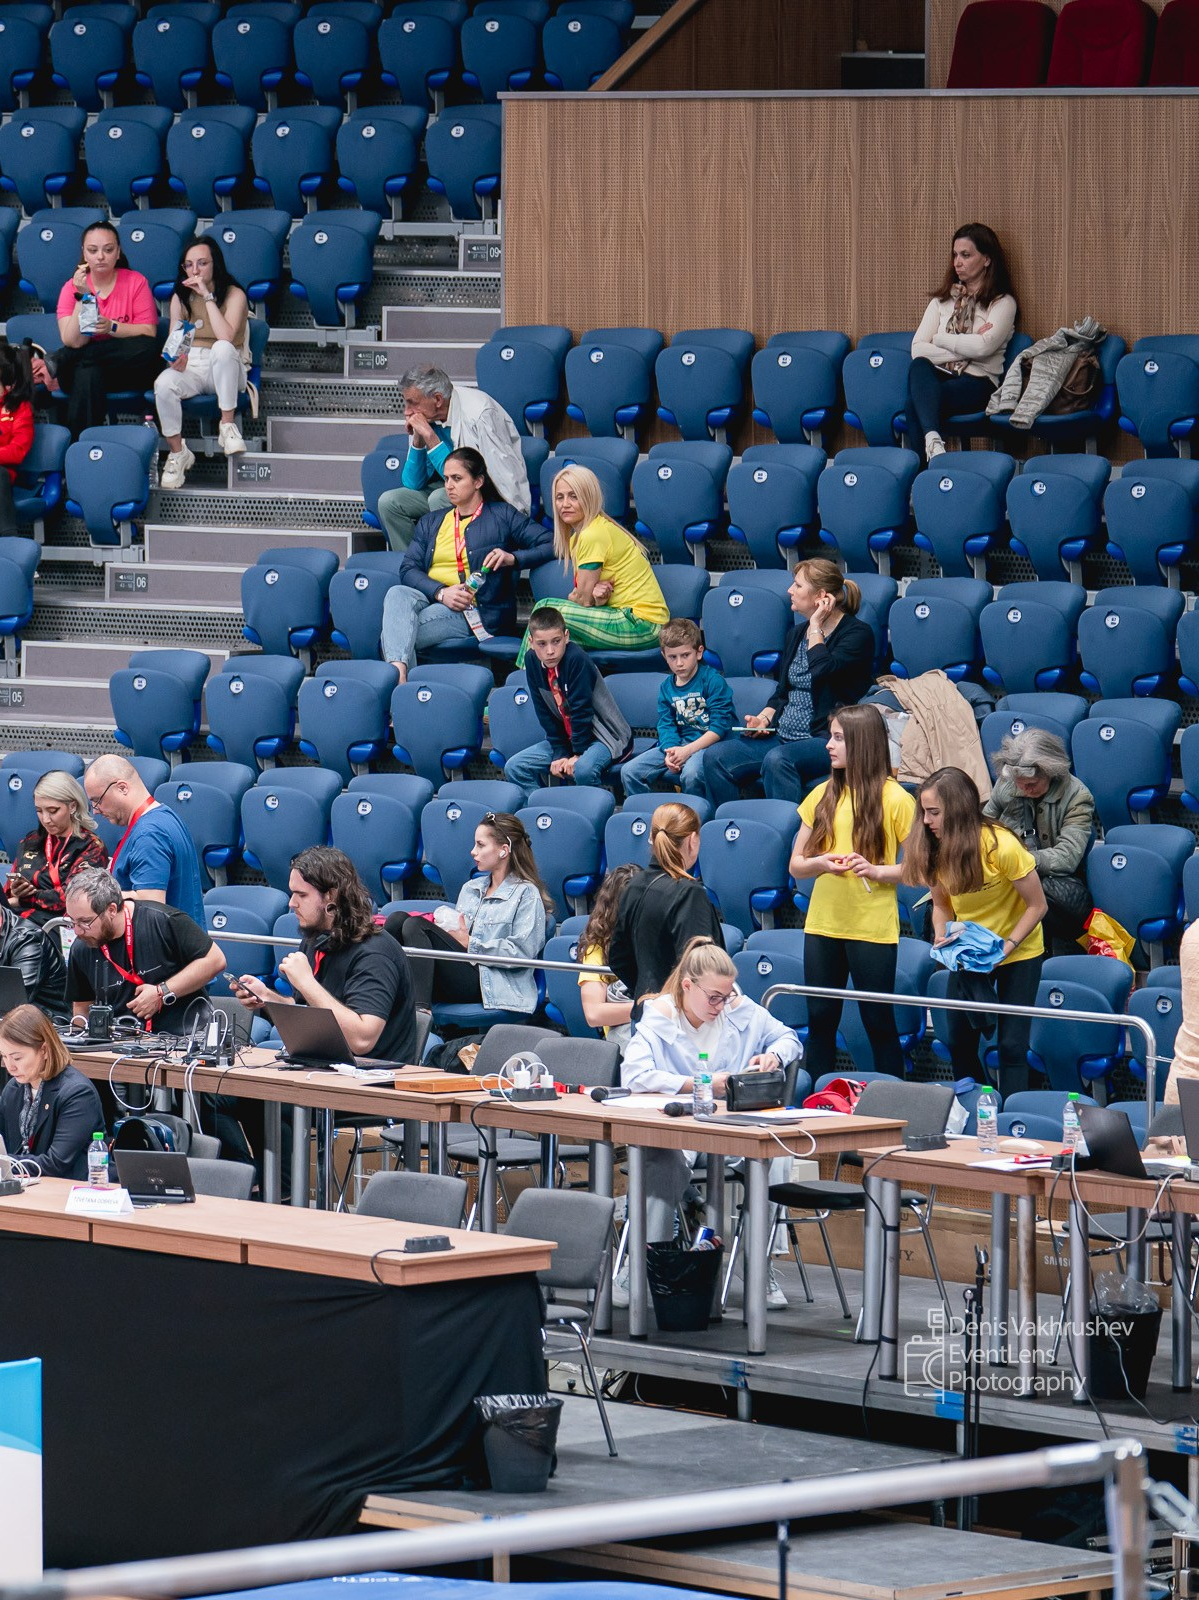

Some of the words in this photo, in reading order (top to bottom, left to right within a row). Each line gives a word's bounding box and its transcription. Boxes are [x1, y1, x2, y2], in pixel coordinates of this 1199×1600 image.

[259, 467, 268, 477] 07
[136, 576, 146, 588] 06
[12, 692, 22, 702] 05
